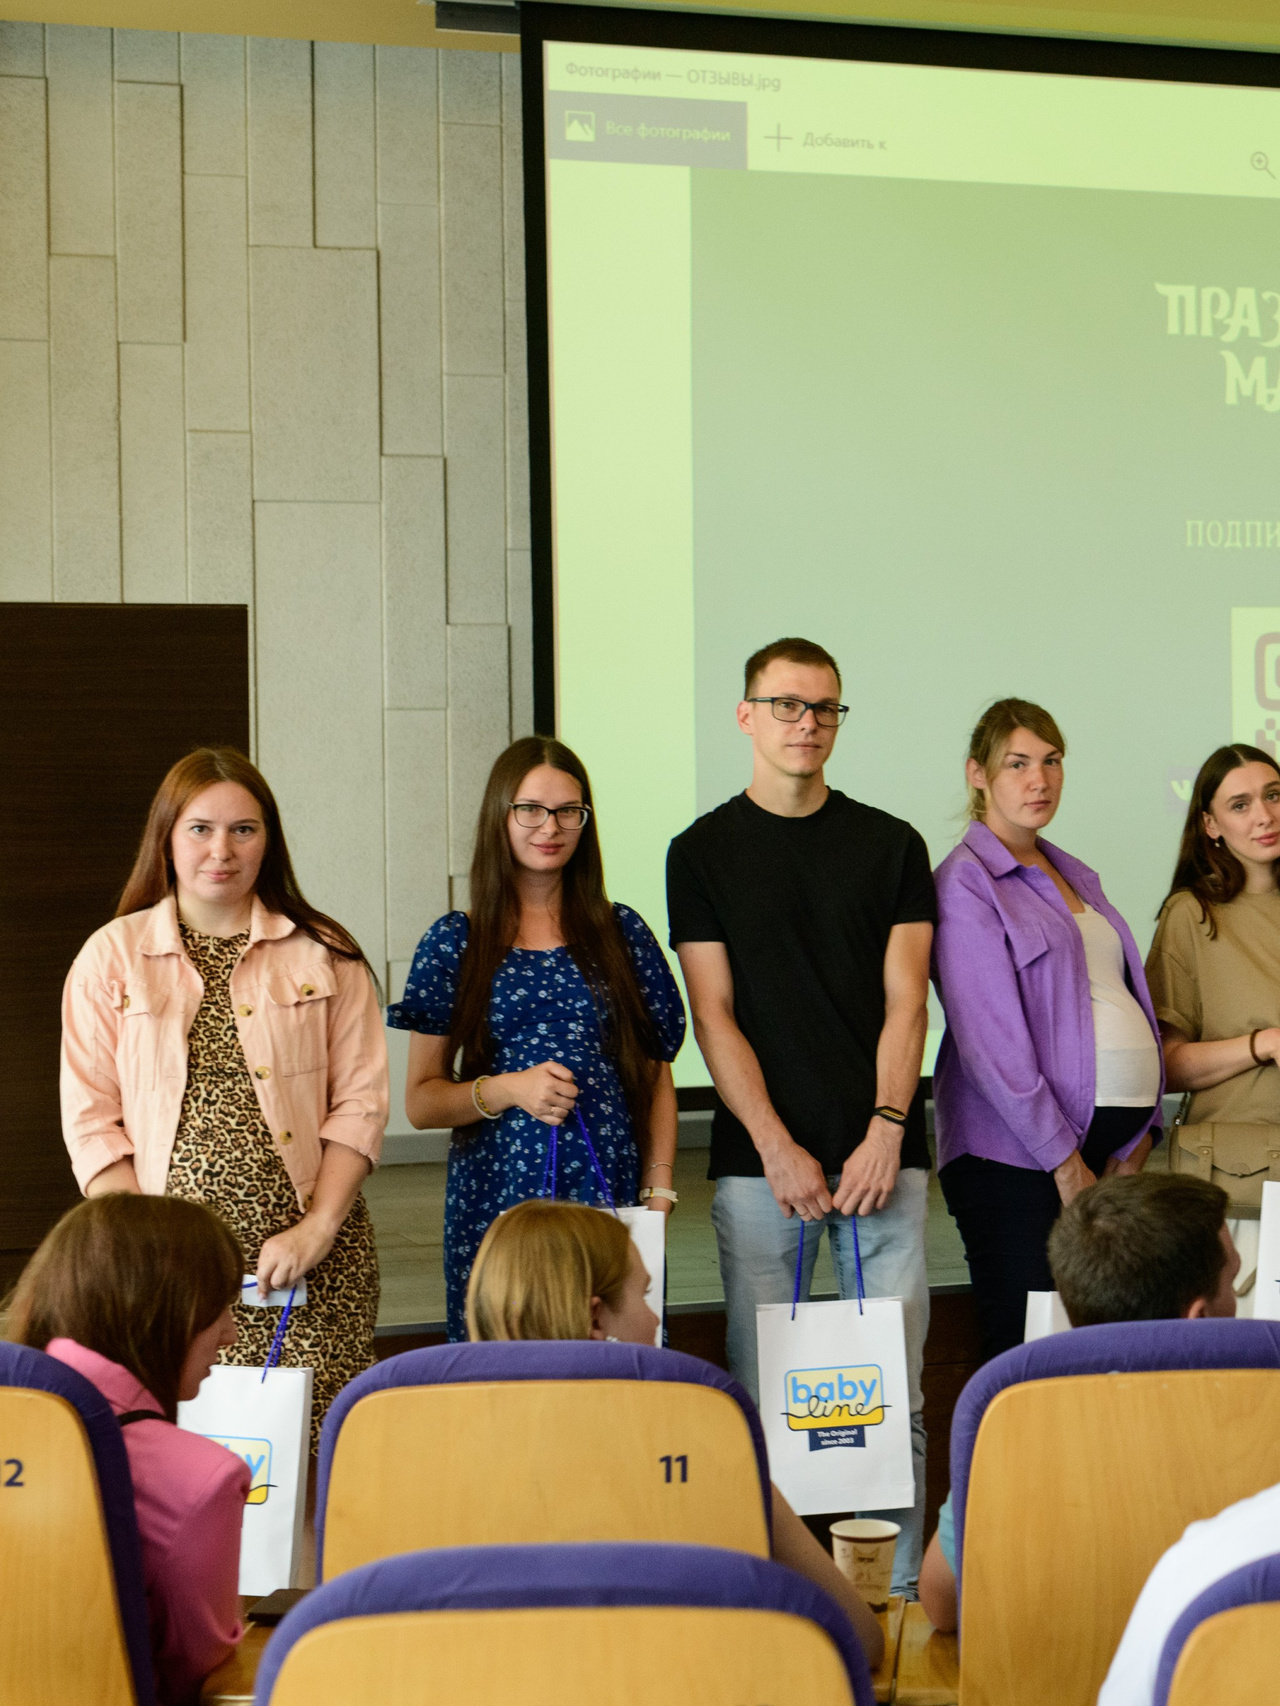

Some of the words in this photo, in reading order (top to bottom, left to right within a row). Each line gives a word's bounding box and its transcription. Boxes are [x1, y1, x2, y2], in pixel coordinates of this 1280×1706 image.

[565, 62, 662, 83] Фотографии
[686, 69, 782, 92] ОТЗЫВЫ.jpg
[605, 120, 633, 137] Все
[636, 122, 731, 143] фотографии
[803, 132, 873, 152] Добавить
[878, 140, 887, 150] к
[791, 1373, 878, 1406] baby
[780, 1395, 893, 1419] line
[830, 1428, 858, 1438] Original
[0, 1458, 25, 1488] 2
[659, 1454, 688, 1484] 11
